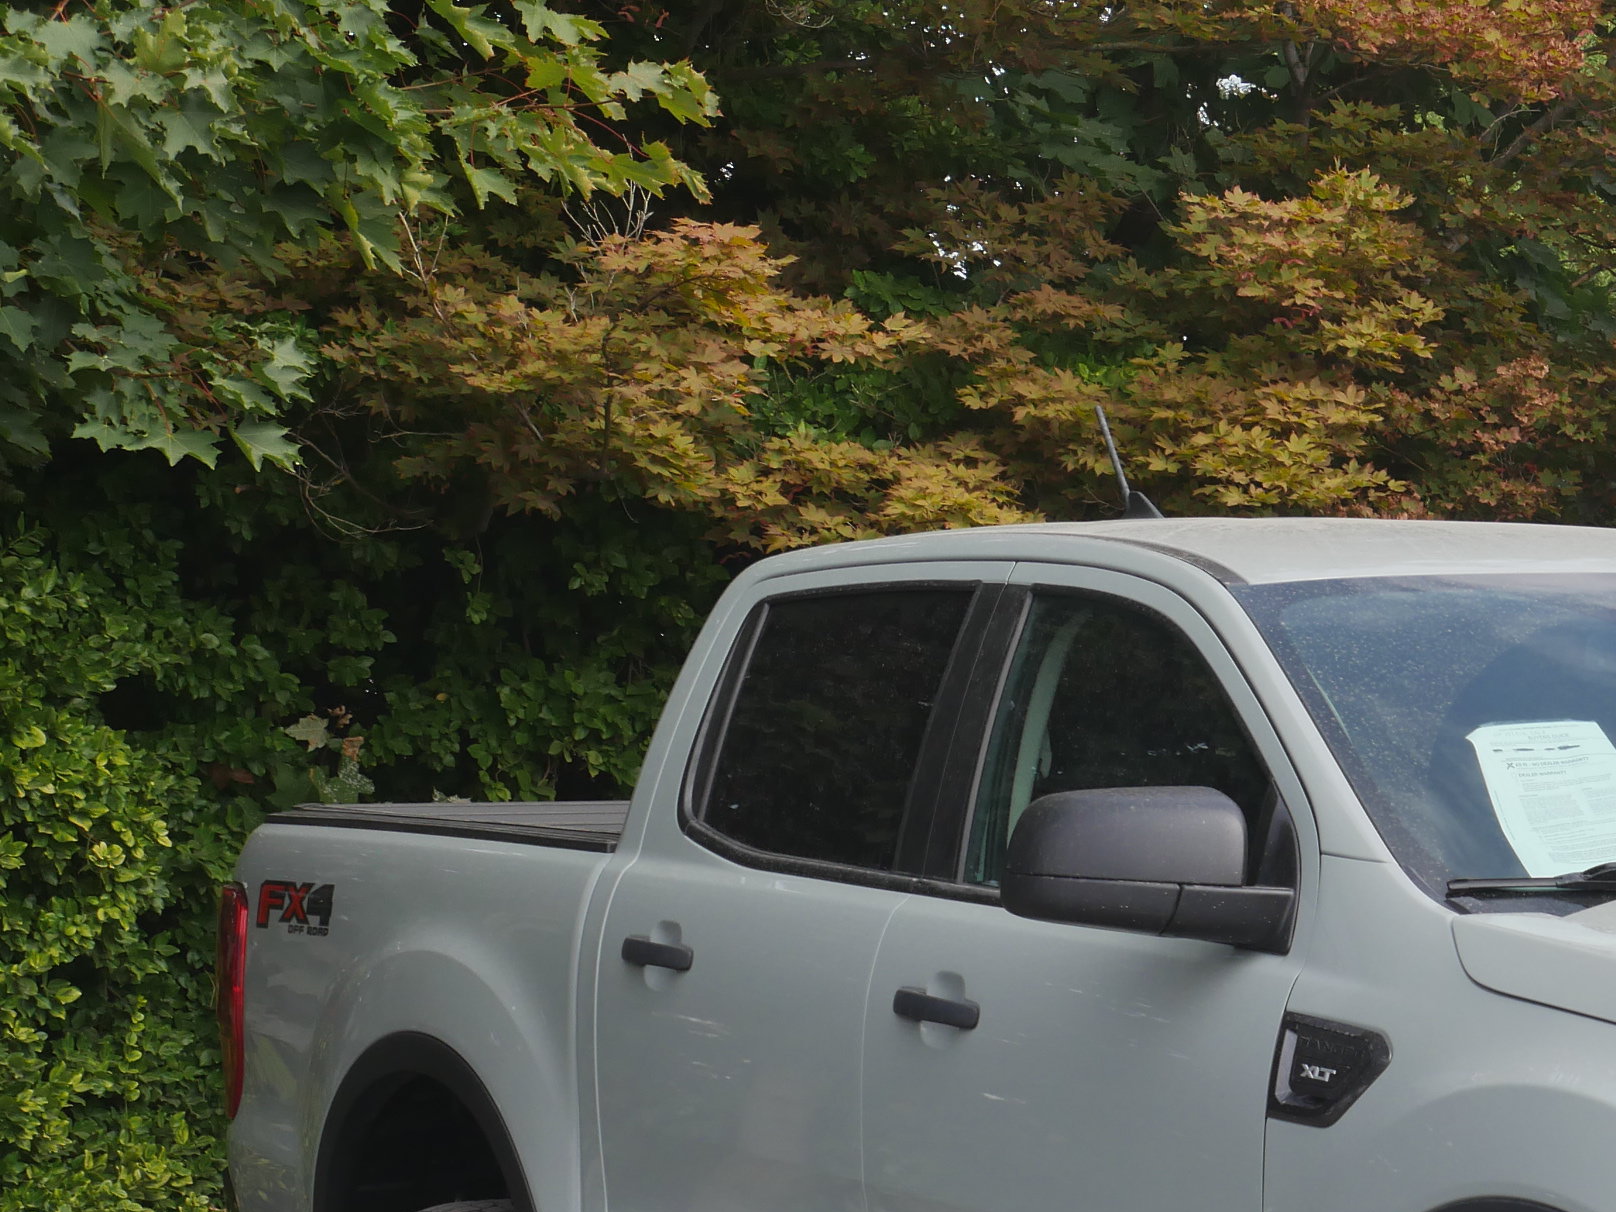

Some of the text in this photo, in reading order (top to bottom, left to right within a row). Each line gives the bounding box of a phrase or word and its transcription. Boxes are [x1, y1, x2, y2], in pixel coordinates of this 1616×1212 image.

[256, 879, 335, 928] FX4
[287, 924, 329, 937] OFF ROAD
[1300, 1063, 1337, 1082] XLT
